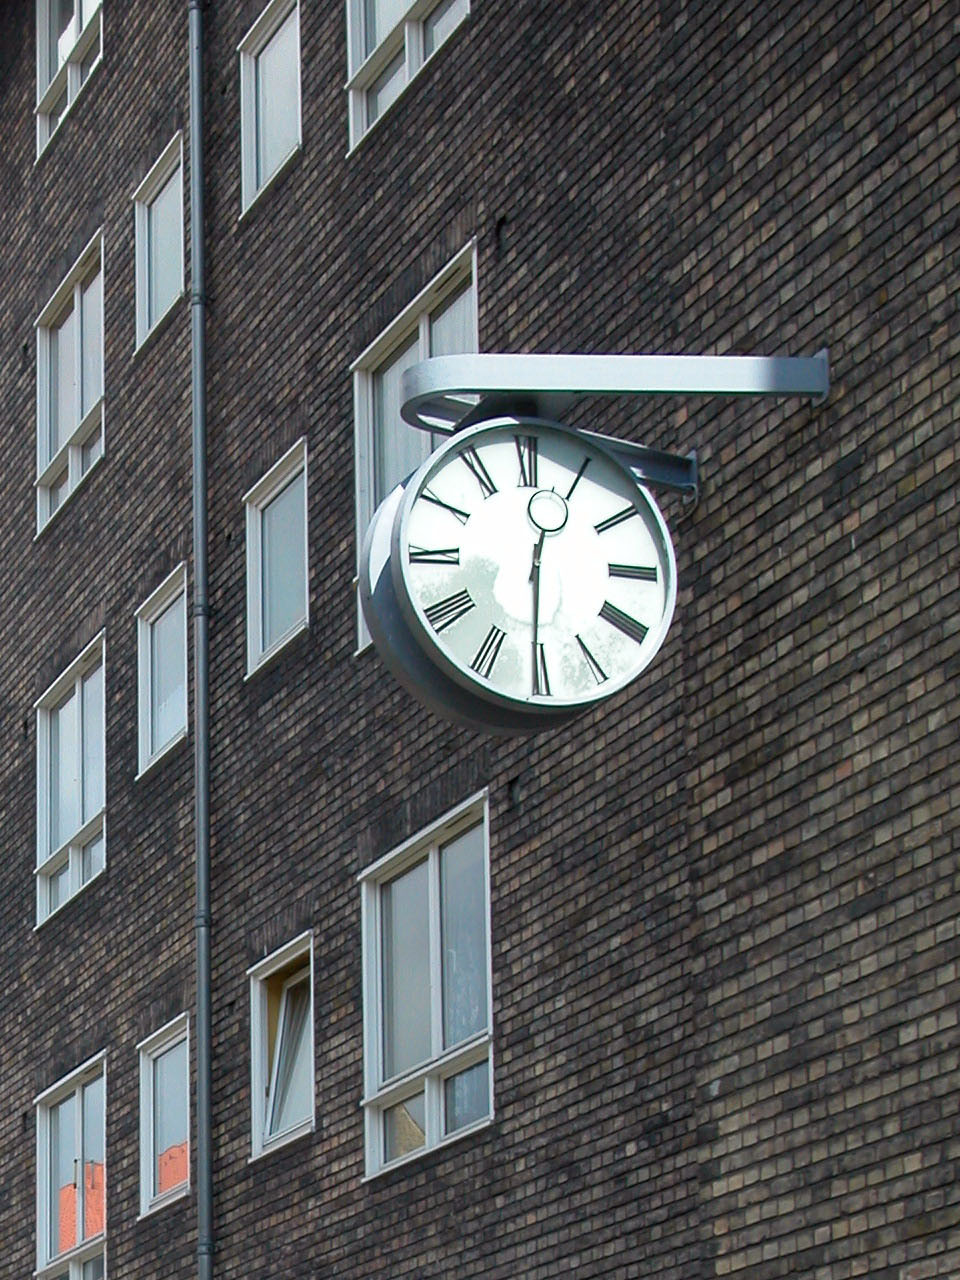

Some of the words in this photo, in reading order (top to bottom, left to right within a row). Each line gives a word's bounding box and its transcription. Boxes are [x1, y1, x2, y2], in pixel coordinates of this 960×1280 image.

[458, 445, 500, 500] XI
[513, 434, 539, 488] XII
[566, 457, 592, 501] I
[420, 486, 472, 526] X
[593, 502, 640, 536] II
[408, 545, 461, 566] IX
[607, 562, 658, 584] III
[423, 587, 478, 635] VIII
[470, 624, 508, 680] VII
[575, 633, 610, 685] V
